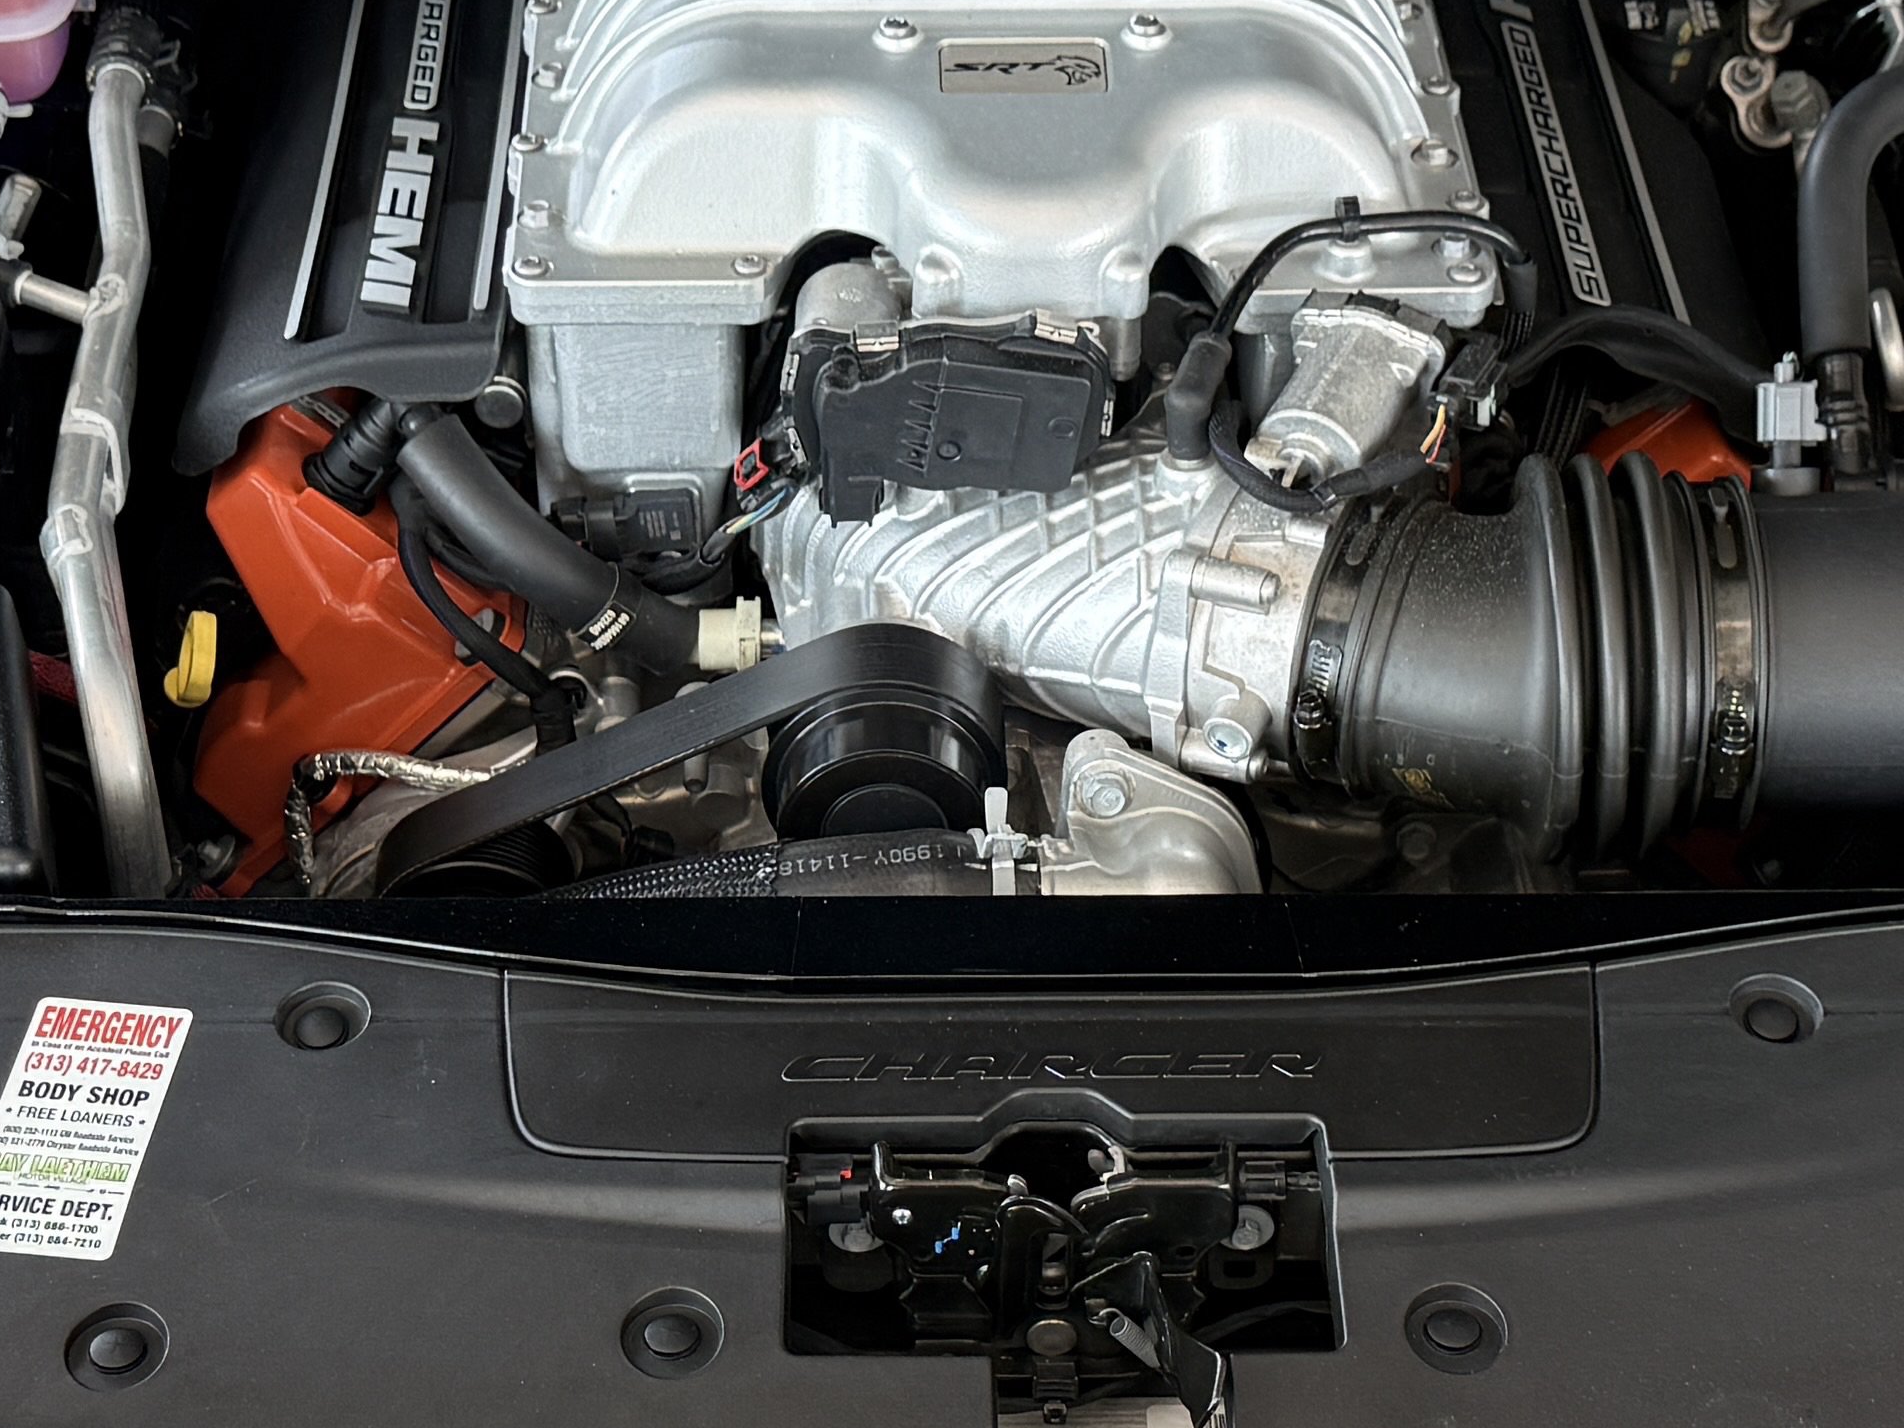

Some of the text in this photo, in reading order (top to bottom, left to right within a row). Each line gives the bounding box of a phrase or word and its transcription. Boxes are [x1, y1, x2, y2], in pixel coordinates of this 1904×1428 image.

[944, 61, 1056, 75] SRT
[1511, 26, 1604, 302] SUPERCHARGED
[360, 116, 441, 309] HEMI
[35, 1006, 183, 1048] EMERGENCY
[23, 1052, 164, 1080] (313) 417-8429
[779, 1051, 1322, 1082] CHARGER
[18, 1080, 150, 1107] BODY SHOP
[16, 1105, 134, 1126] FREE LOANERS
[11, 1217, 41, 1230] (313)
[59, 1200, 113, 1220] DEPT.
[14, 1232, 44, 1245] (313)
